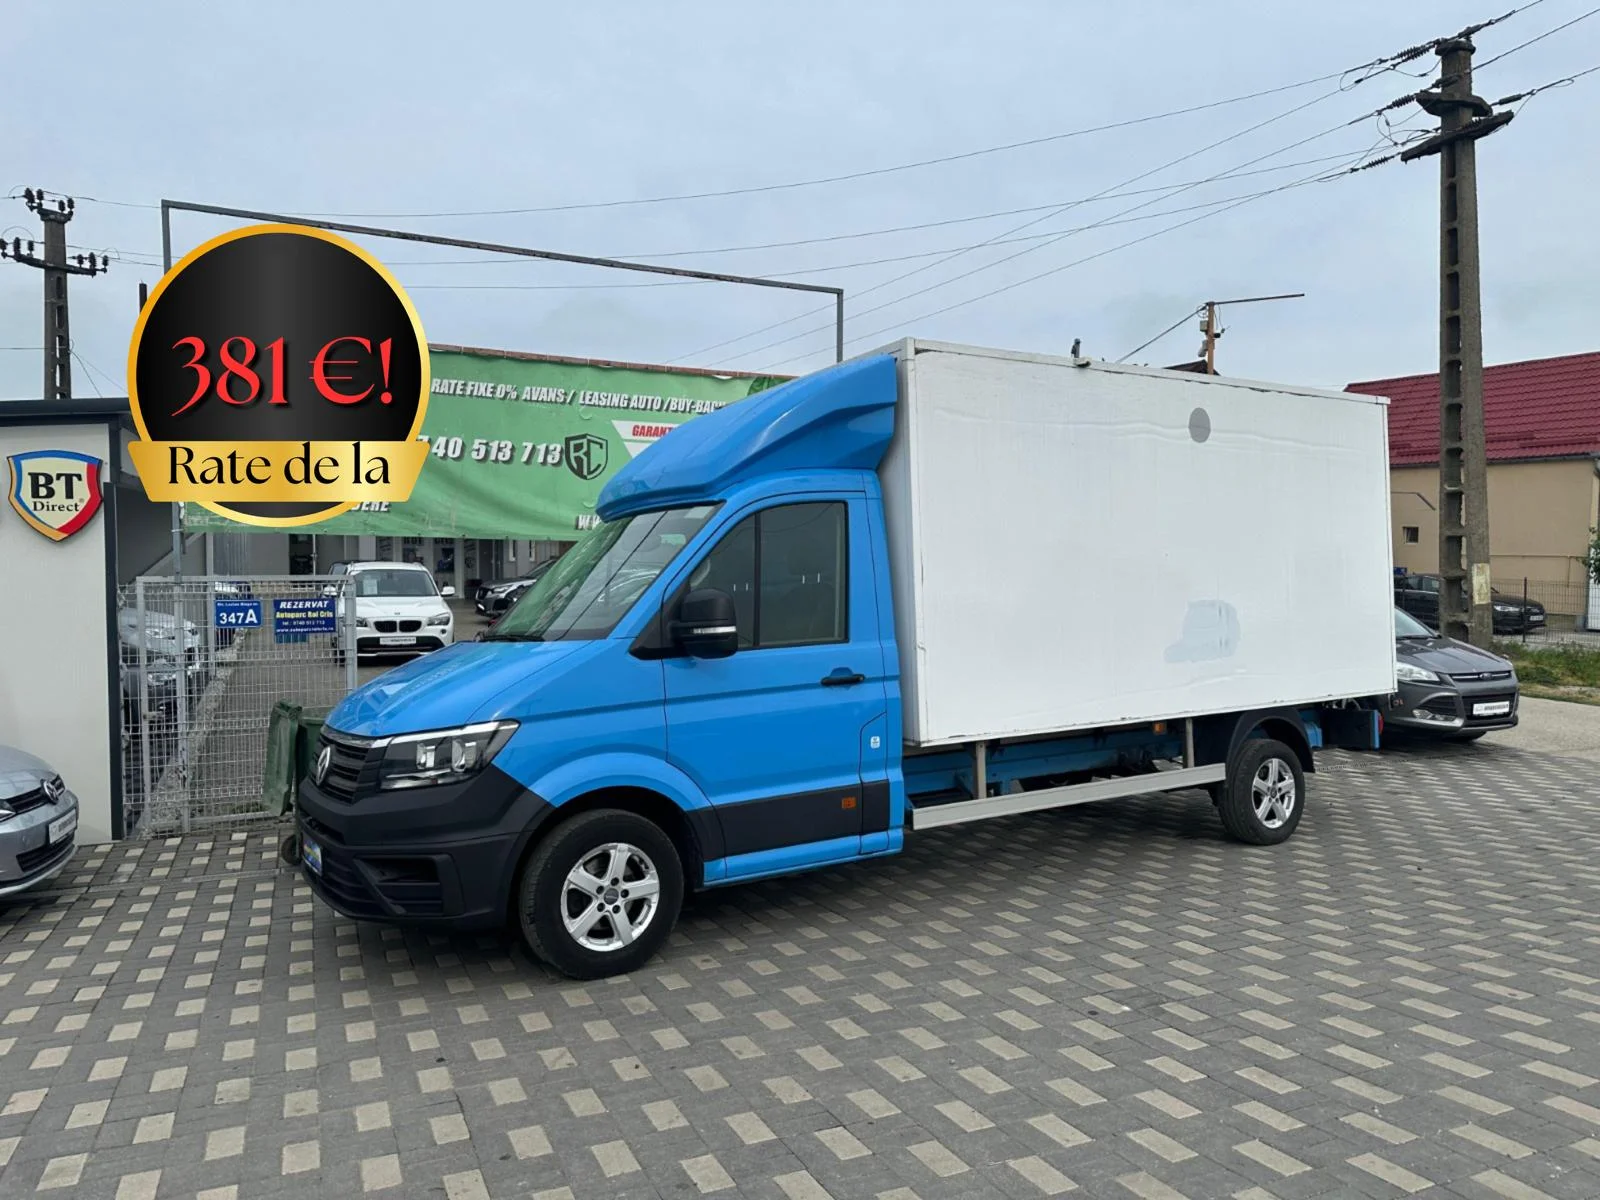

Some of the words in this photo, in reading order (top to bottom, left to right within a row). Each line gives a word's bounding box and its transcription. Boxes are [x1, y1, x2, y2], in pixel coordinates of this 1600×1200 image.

[431, 378, 465, 395] RATE
[466, 381, 496, 398] FIXE
[496, 383, 518, 400] 0%
[522, 386, 566, 403] AVANS
[579, 390, 629, 408] LEASING
[629, 395, 662, 411] AUTO
[471, 438, 512, 462] 513
[521, 441, 562, 464] 713
[28, 472, 83, 500] BT
[32, 500, 80, 512] Direct
[279, 601, 329, 609] REZERVAT
[219, 608, 258, 624] 347A
